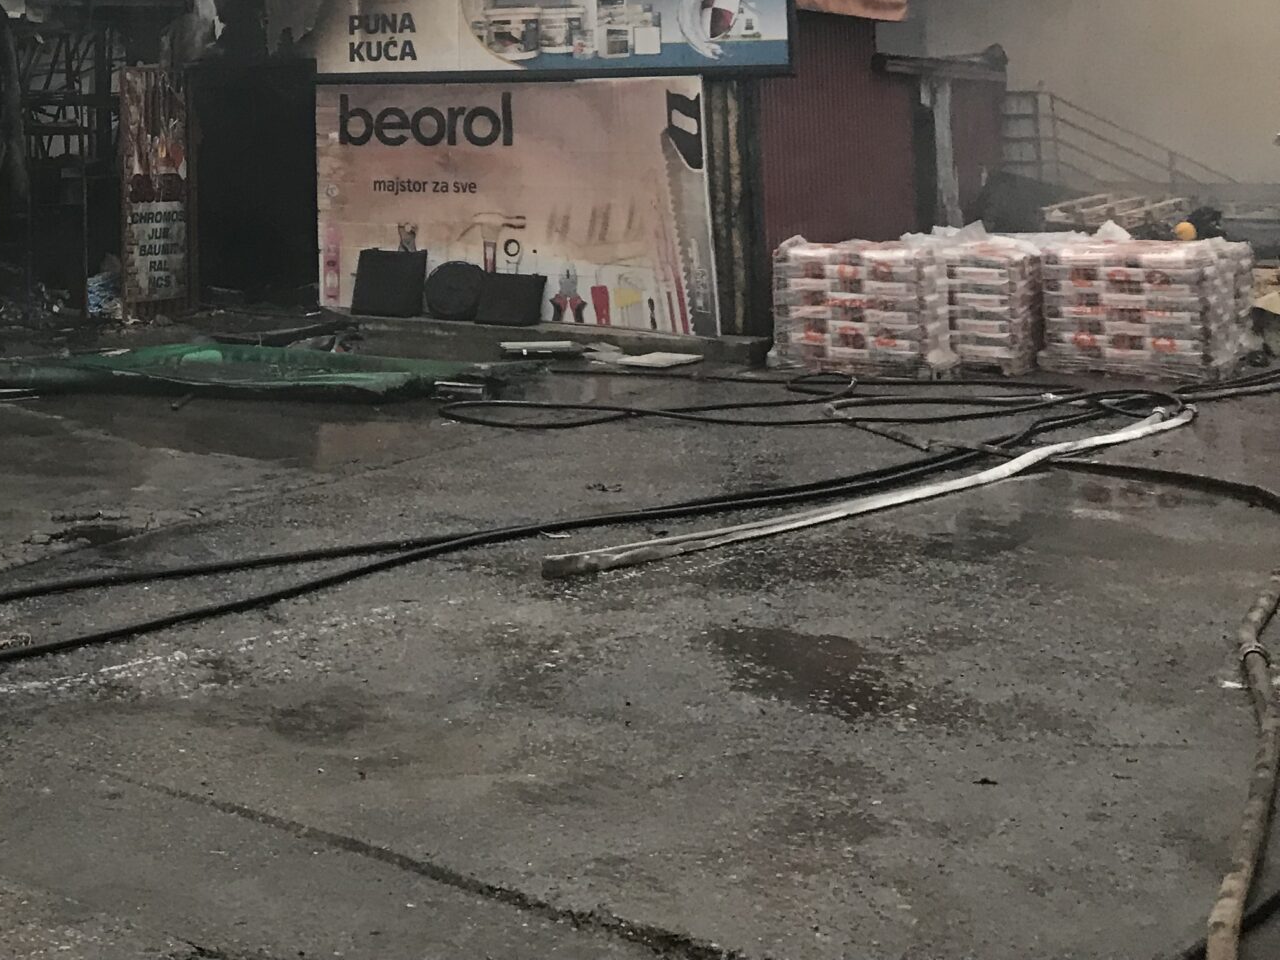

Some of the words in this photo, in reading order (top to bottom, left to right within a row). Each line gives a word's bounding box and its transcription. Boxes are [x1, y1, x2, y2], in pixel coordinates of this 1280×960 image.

[349, 12, 417, 36] PUNA
[349, 36, 418, 63] KUĆA
[339, 92, 514, 146] beorol
[373, 177, 428, 197] majstor
[432, 181, 450, 194] za
[452, 181, 478, 194] sve
[131, 210, 185, 225] CHROMOS
[149, 260, 170, 273] RAL
